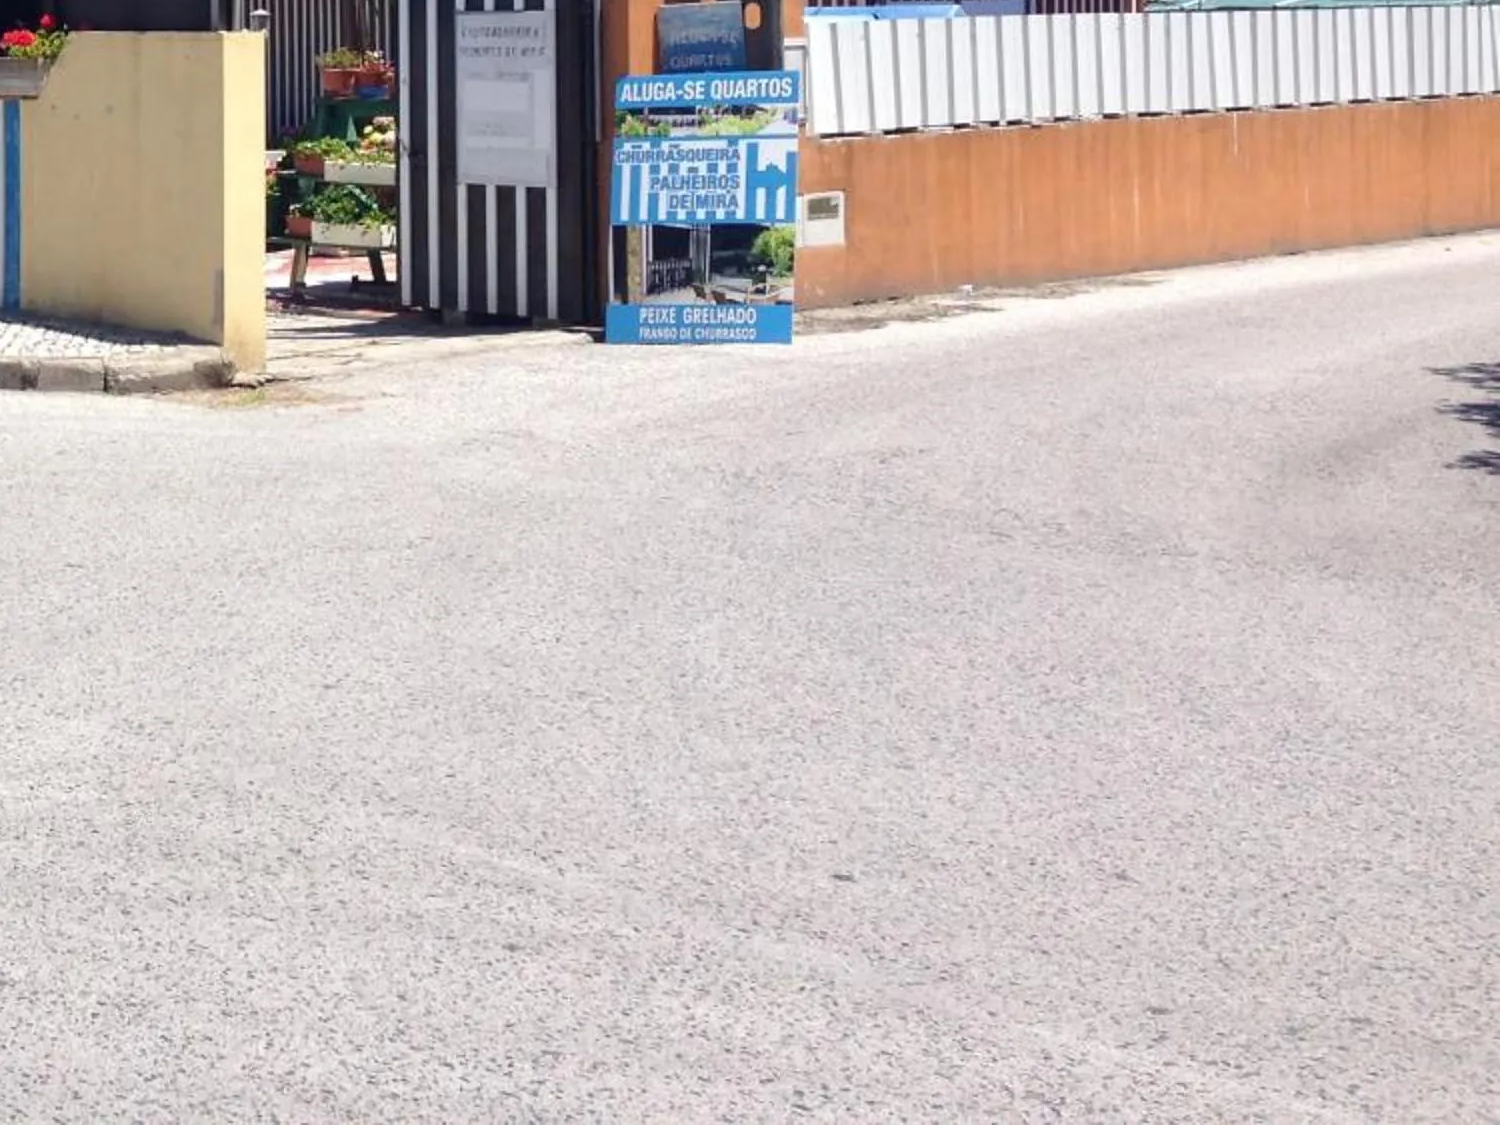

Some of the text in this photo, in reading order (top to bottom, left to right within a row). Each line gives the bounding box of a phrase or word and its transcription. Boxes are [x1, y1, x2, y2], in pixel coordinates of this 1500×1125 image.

[621, 78, 792, 102] ALUGA-SE QUARTOS
[617, 148, 740, 163] CHURRASQUEIRA
[651, 174, 740, 191] PALHEIROS
[669, 194, 739, 210] DE MIRA
[639, 307, 756, 324] PEIXE GRELHADO
